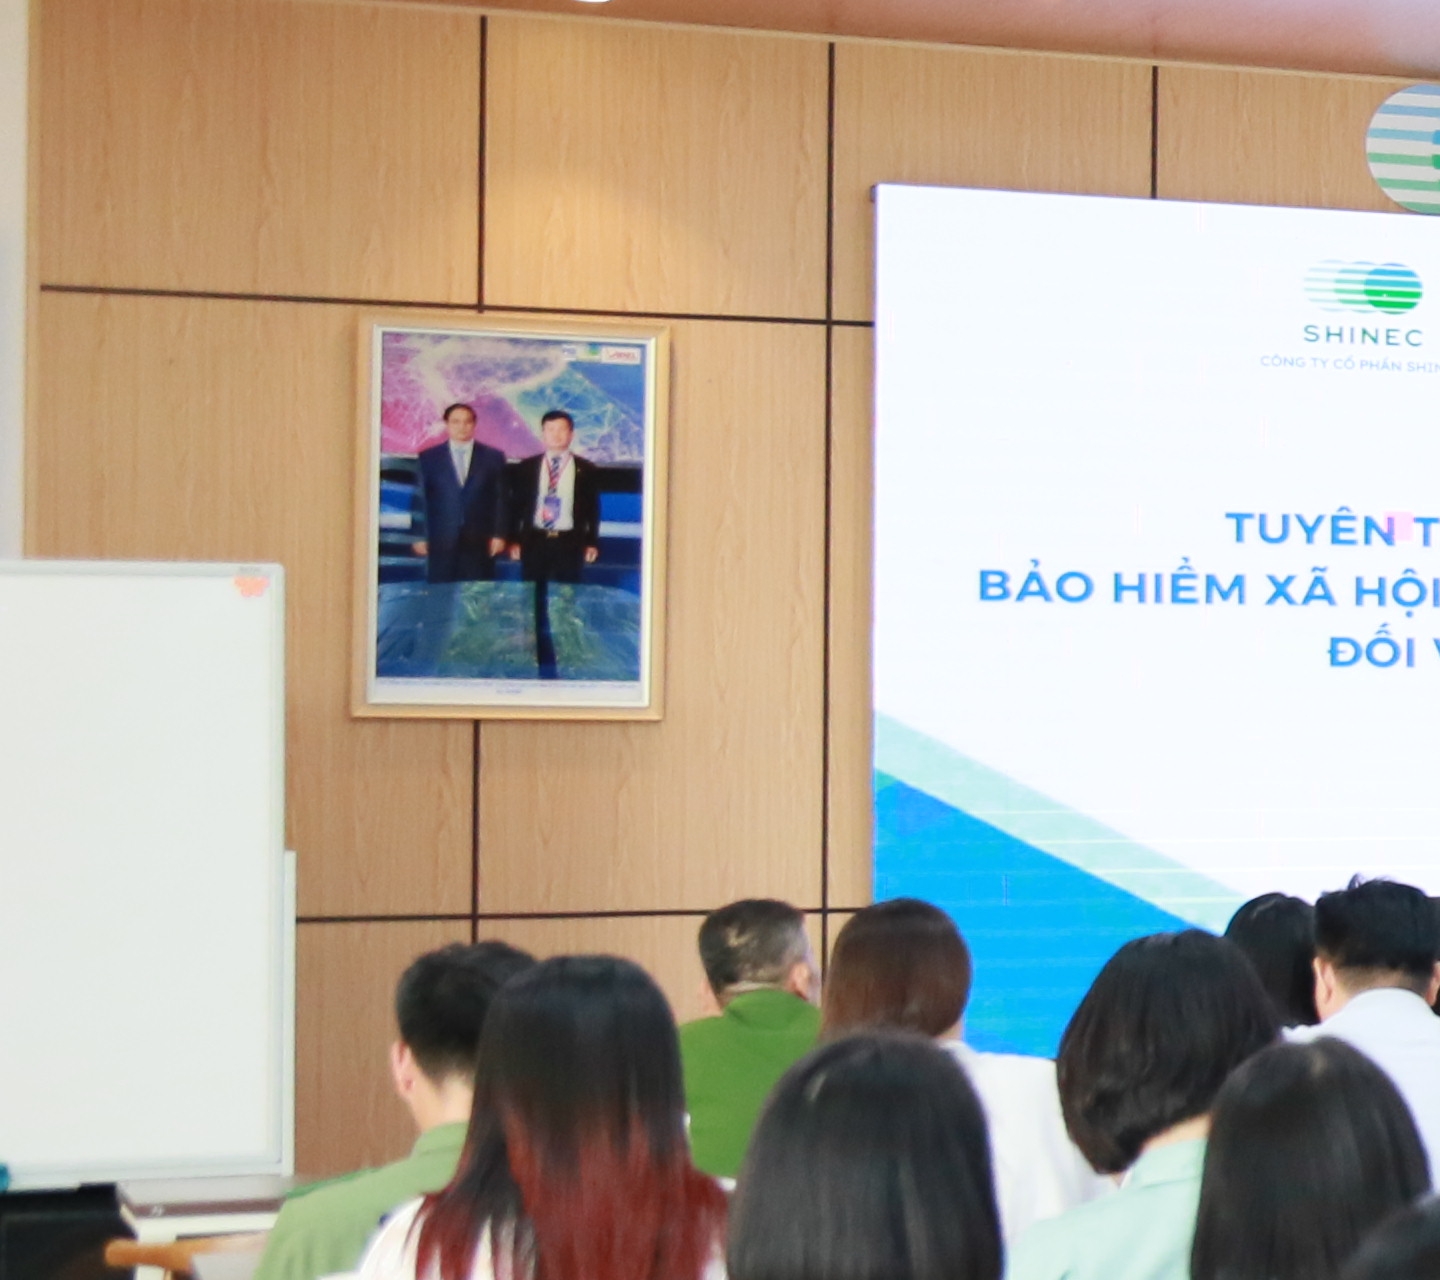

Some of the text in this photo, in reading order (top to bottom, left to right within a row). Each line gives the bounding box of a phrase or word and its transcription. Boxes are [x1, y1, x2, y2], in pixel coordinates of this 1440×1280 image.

[1304, 325, 1422, 347] SHINEC
[1259, 353, 1306, 369] CÔNG
[1310, 356, 1329, 369] TY
[1225, 506, 1395, 546] TUYÊN
[979, 559, 1094, 603] BẢO
[1114, 557, 1245, 605] HIỂM
[1265, 566, 1336, 606] XÃ
[1327, 623, 1414, 668] ĐỐI
